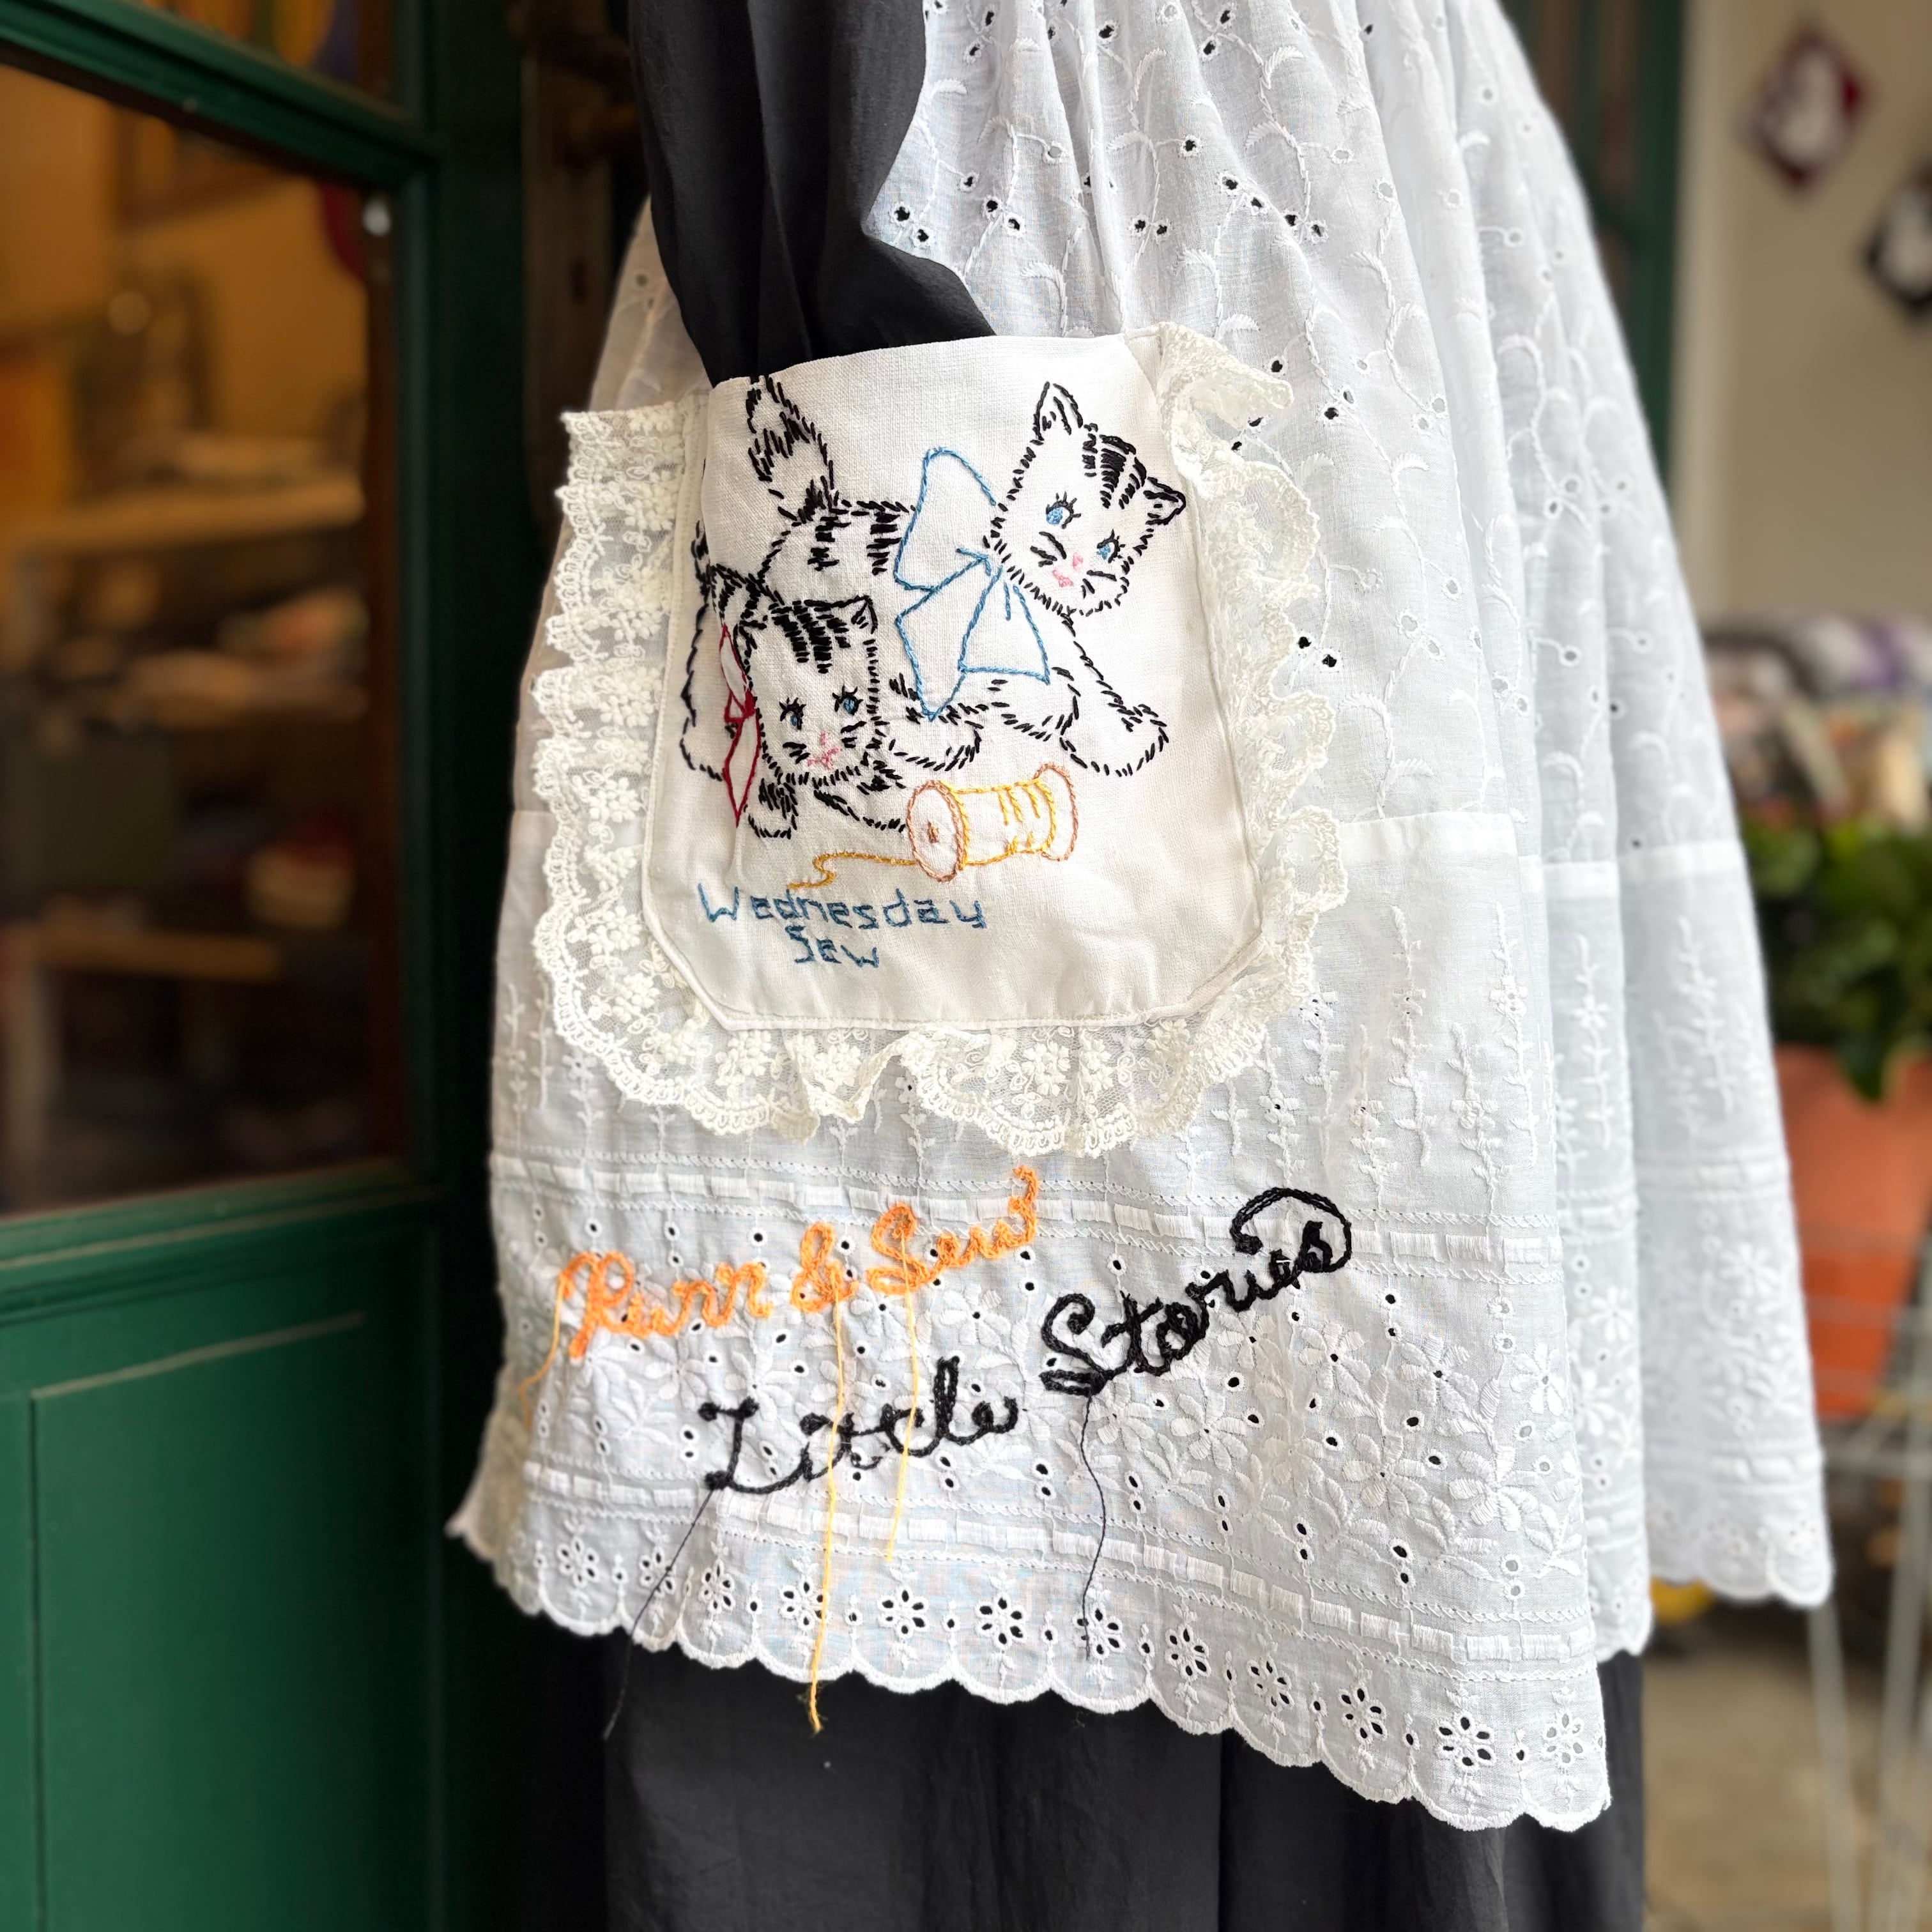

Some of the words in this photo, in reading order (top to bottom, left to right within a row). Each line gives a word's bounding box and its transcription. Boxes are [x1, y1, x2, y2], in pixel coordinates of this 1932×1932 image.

[698, 883, 988, 930] Wednesday
[785, 924, 880, 969] Sew
[790, 1221, 860, 1314] &
[698, 1355, 1020, 1496] Little
[1038, 1186, 1353, 1397] Stories
